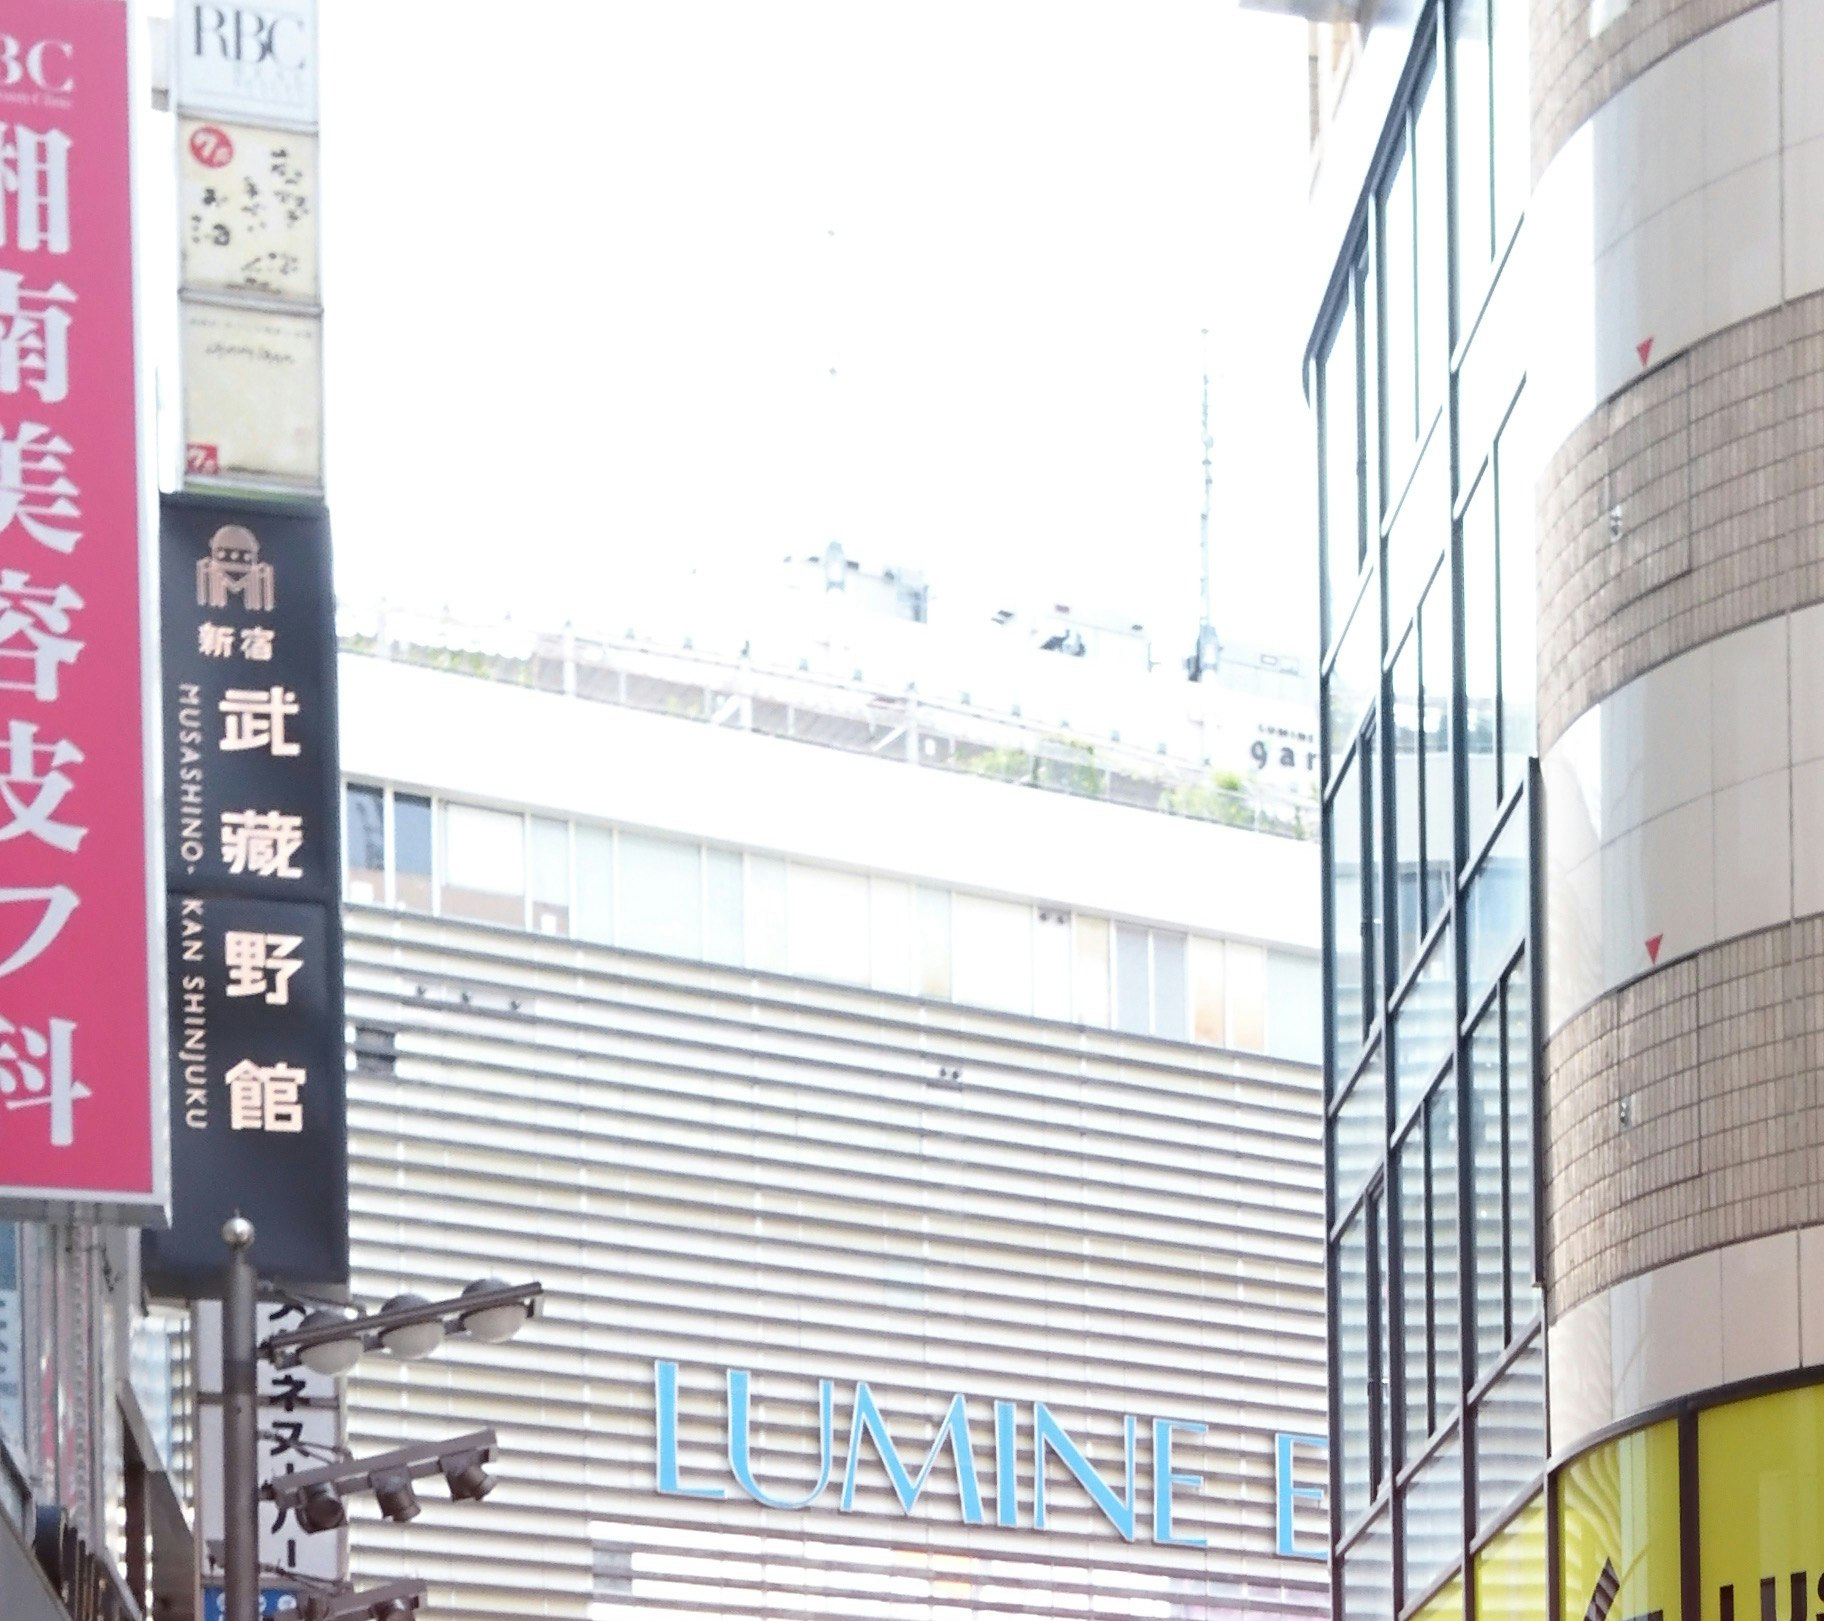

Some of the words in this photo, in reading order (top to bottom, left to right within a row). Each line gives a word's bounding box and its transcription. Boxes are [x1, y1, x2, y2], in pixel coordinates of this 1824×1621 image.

[198, 620, 276, 661] 新宿
[179, 974, 208, 1129] SHINJUKU
[652, 1359, 1207, 1546] LUMINE
